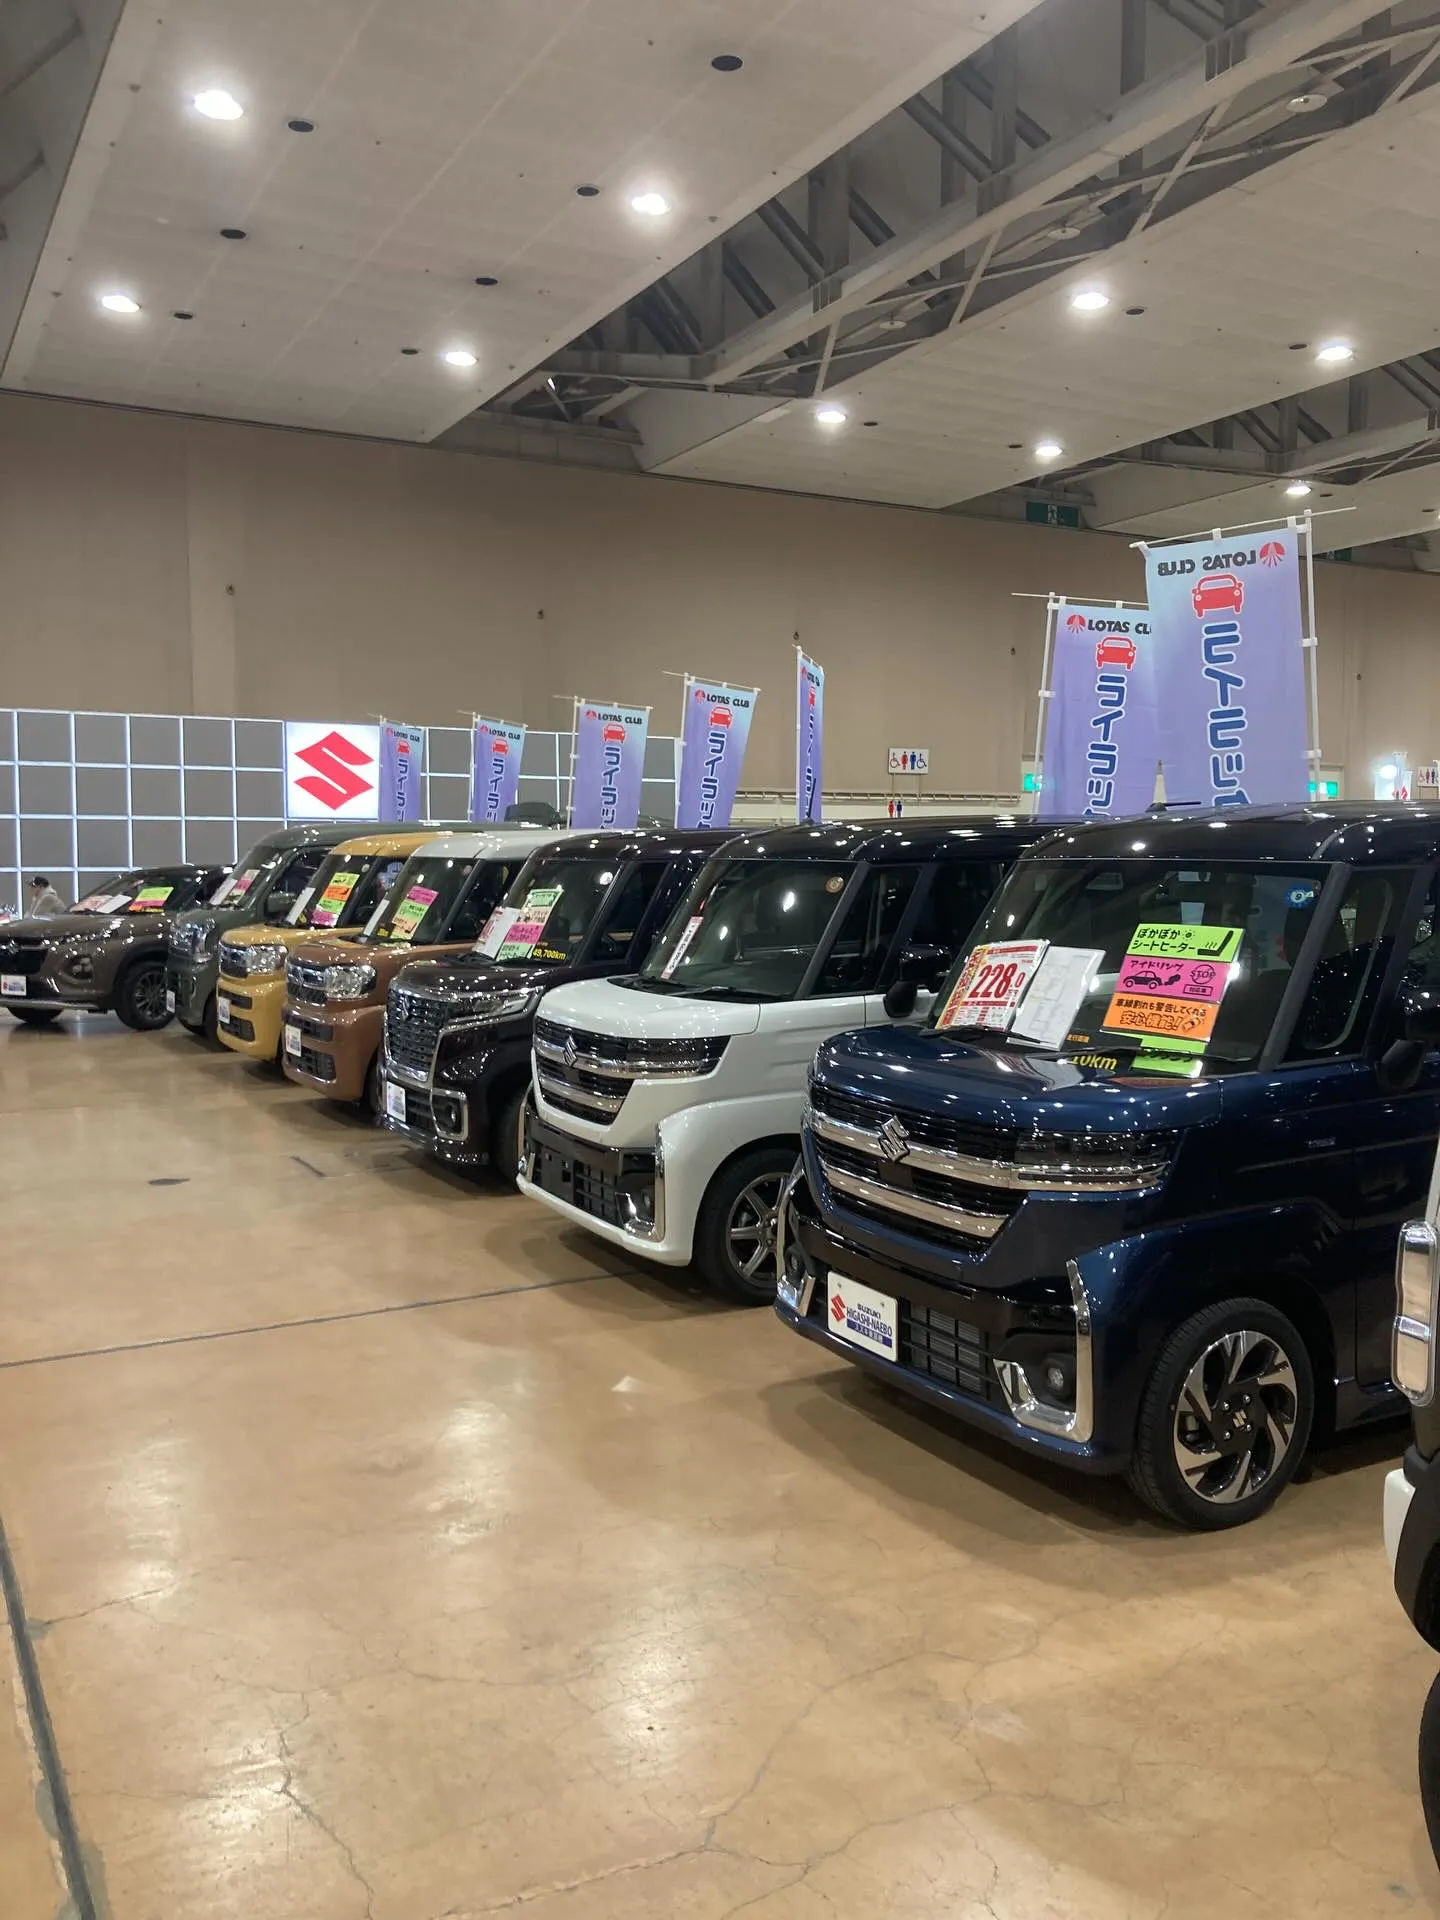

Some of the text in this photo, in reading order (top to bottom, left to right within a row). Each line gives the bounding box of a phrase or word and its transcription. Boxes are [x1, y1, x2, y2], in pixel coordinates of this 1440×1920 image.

[1088, 619, 1152, 634] LOTAS CL
[707, 693, 750, 708] LOTAS CLUB
[598, 713, 643, 725] LOTAS CLUB
[489, 728, 521, 740] LOTAS CLUB
[1083, 673, 1127, 815] ライラッ
[601, 746, 621, 829] ライラッ
[1131, 940, 1196, 953] シートヒーター
[1130, 960, 1184, 972] アイドリング
[1190, 969, 1216, 978] STOP
[857, 1303, 881, 1320] SUZUKI
[846, 1307, 893, 1337] HIGASHI-NAEBO
